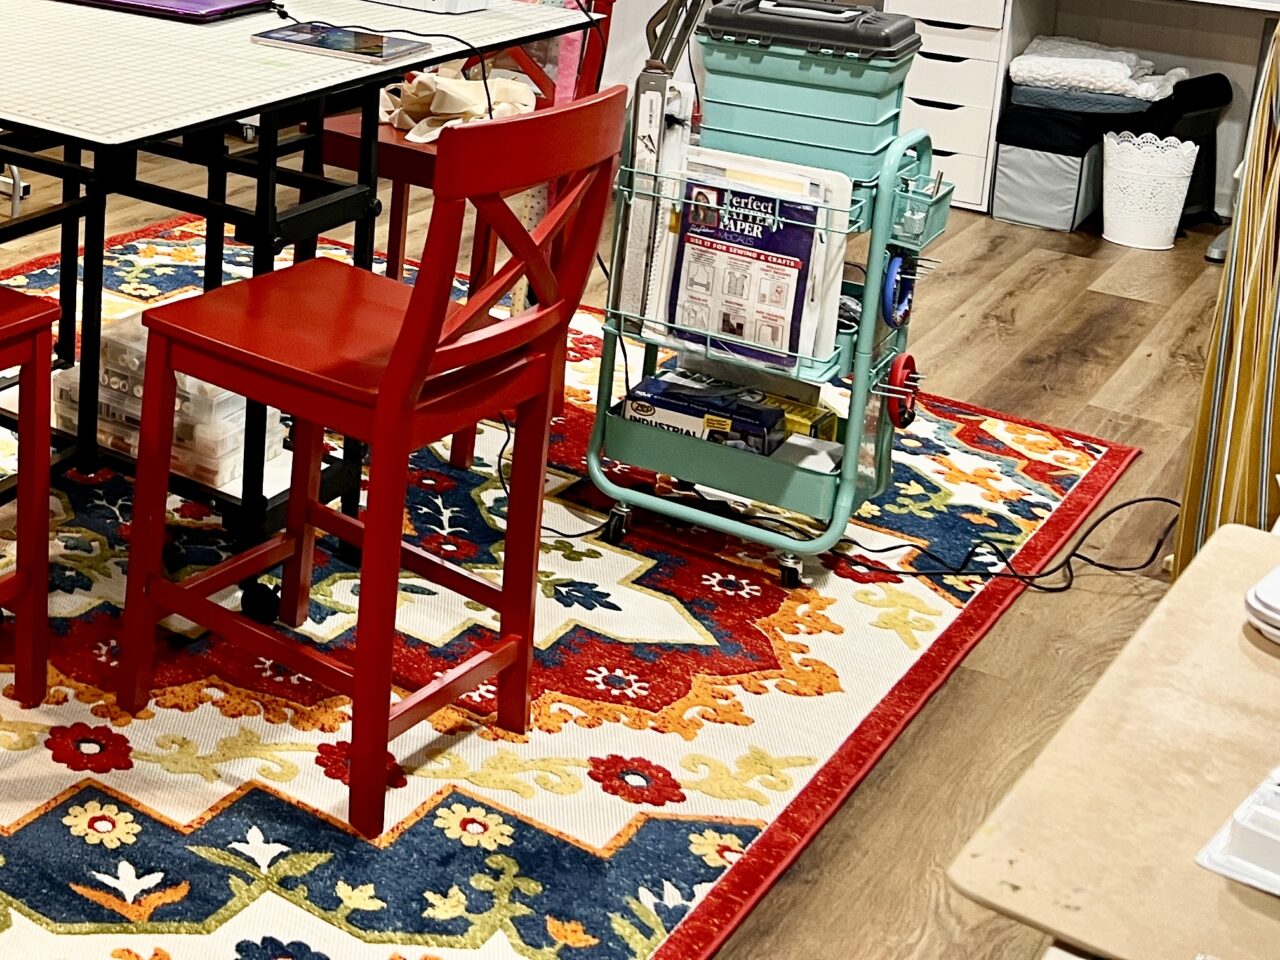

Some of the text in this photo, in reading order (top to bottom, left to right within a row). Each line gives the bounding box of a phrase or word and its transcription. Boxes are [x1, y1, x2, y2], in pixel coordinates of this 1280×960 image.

[723, 191, 773, 214] Perfect
[690, 237, 702, 246] USE
[704, 239, 711, 247] IT
[712, 242, 727, 252] FOR
[729, 246, 758, 259] SEWING
[767, 255, 795, 267] CRAFTS
[629, 415, 697, 438] INDUSTRIAL
